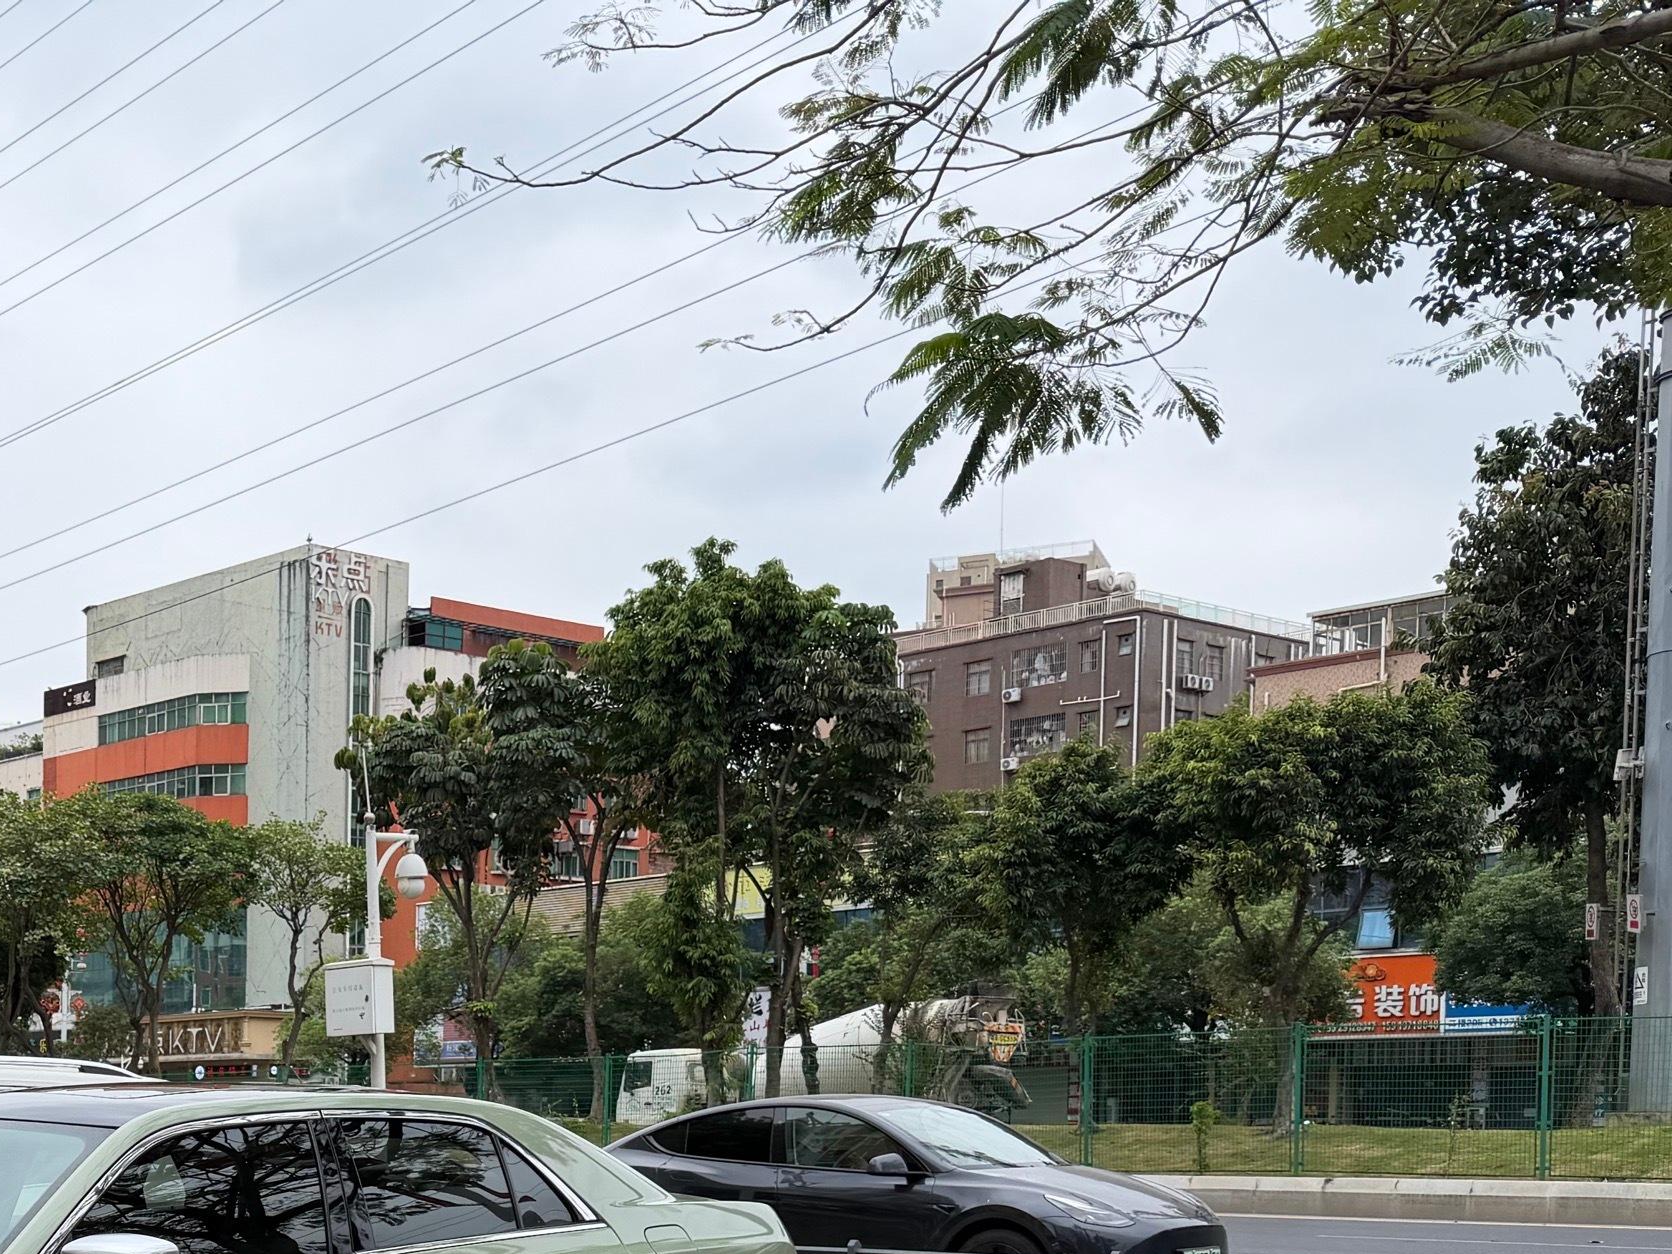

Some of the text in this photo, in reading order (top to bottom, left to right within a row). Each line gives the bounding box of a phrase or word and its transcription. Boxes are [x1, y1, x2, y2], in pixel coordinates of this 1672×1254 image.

[311, 585, 349, 608] KTV
[315, 620, 343, 638] KTV
[169, 1026, 222, 1054] KTV
[655, 1085, 672, 1096] 262
